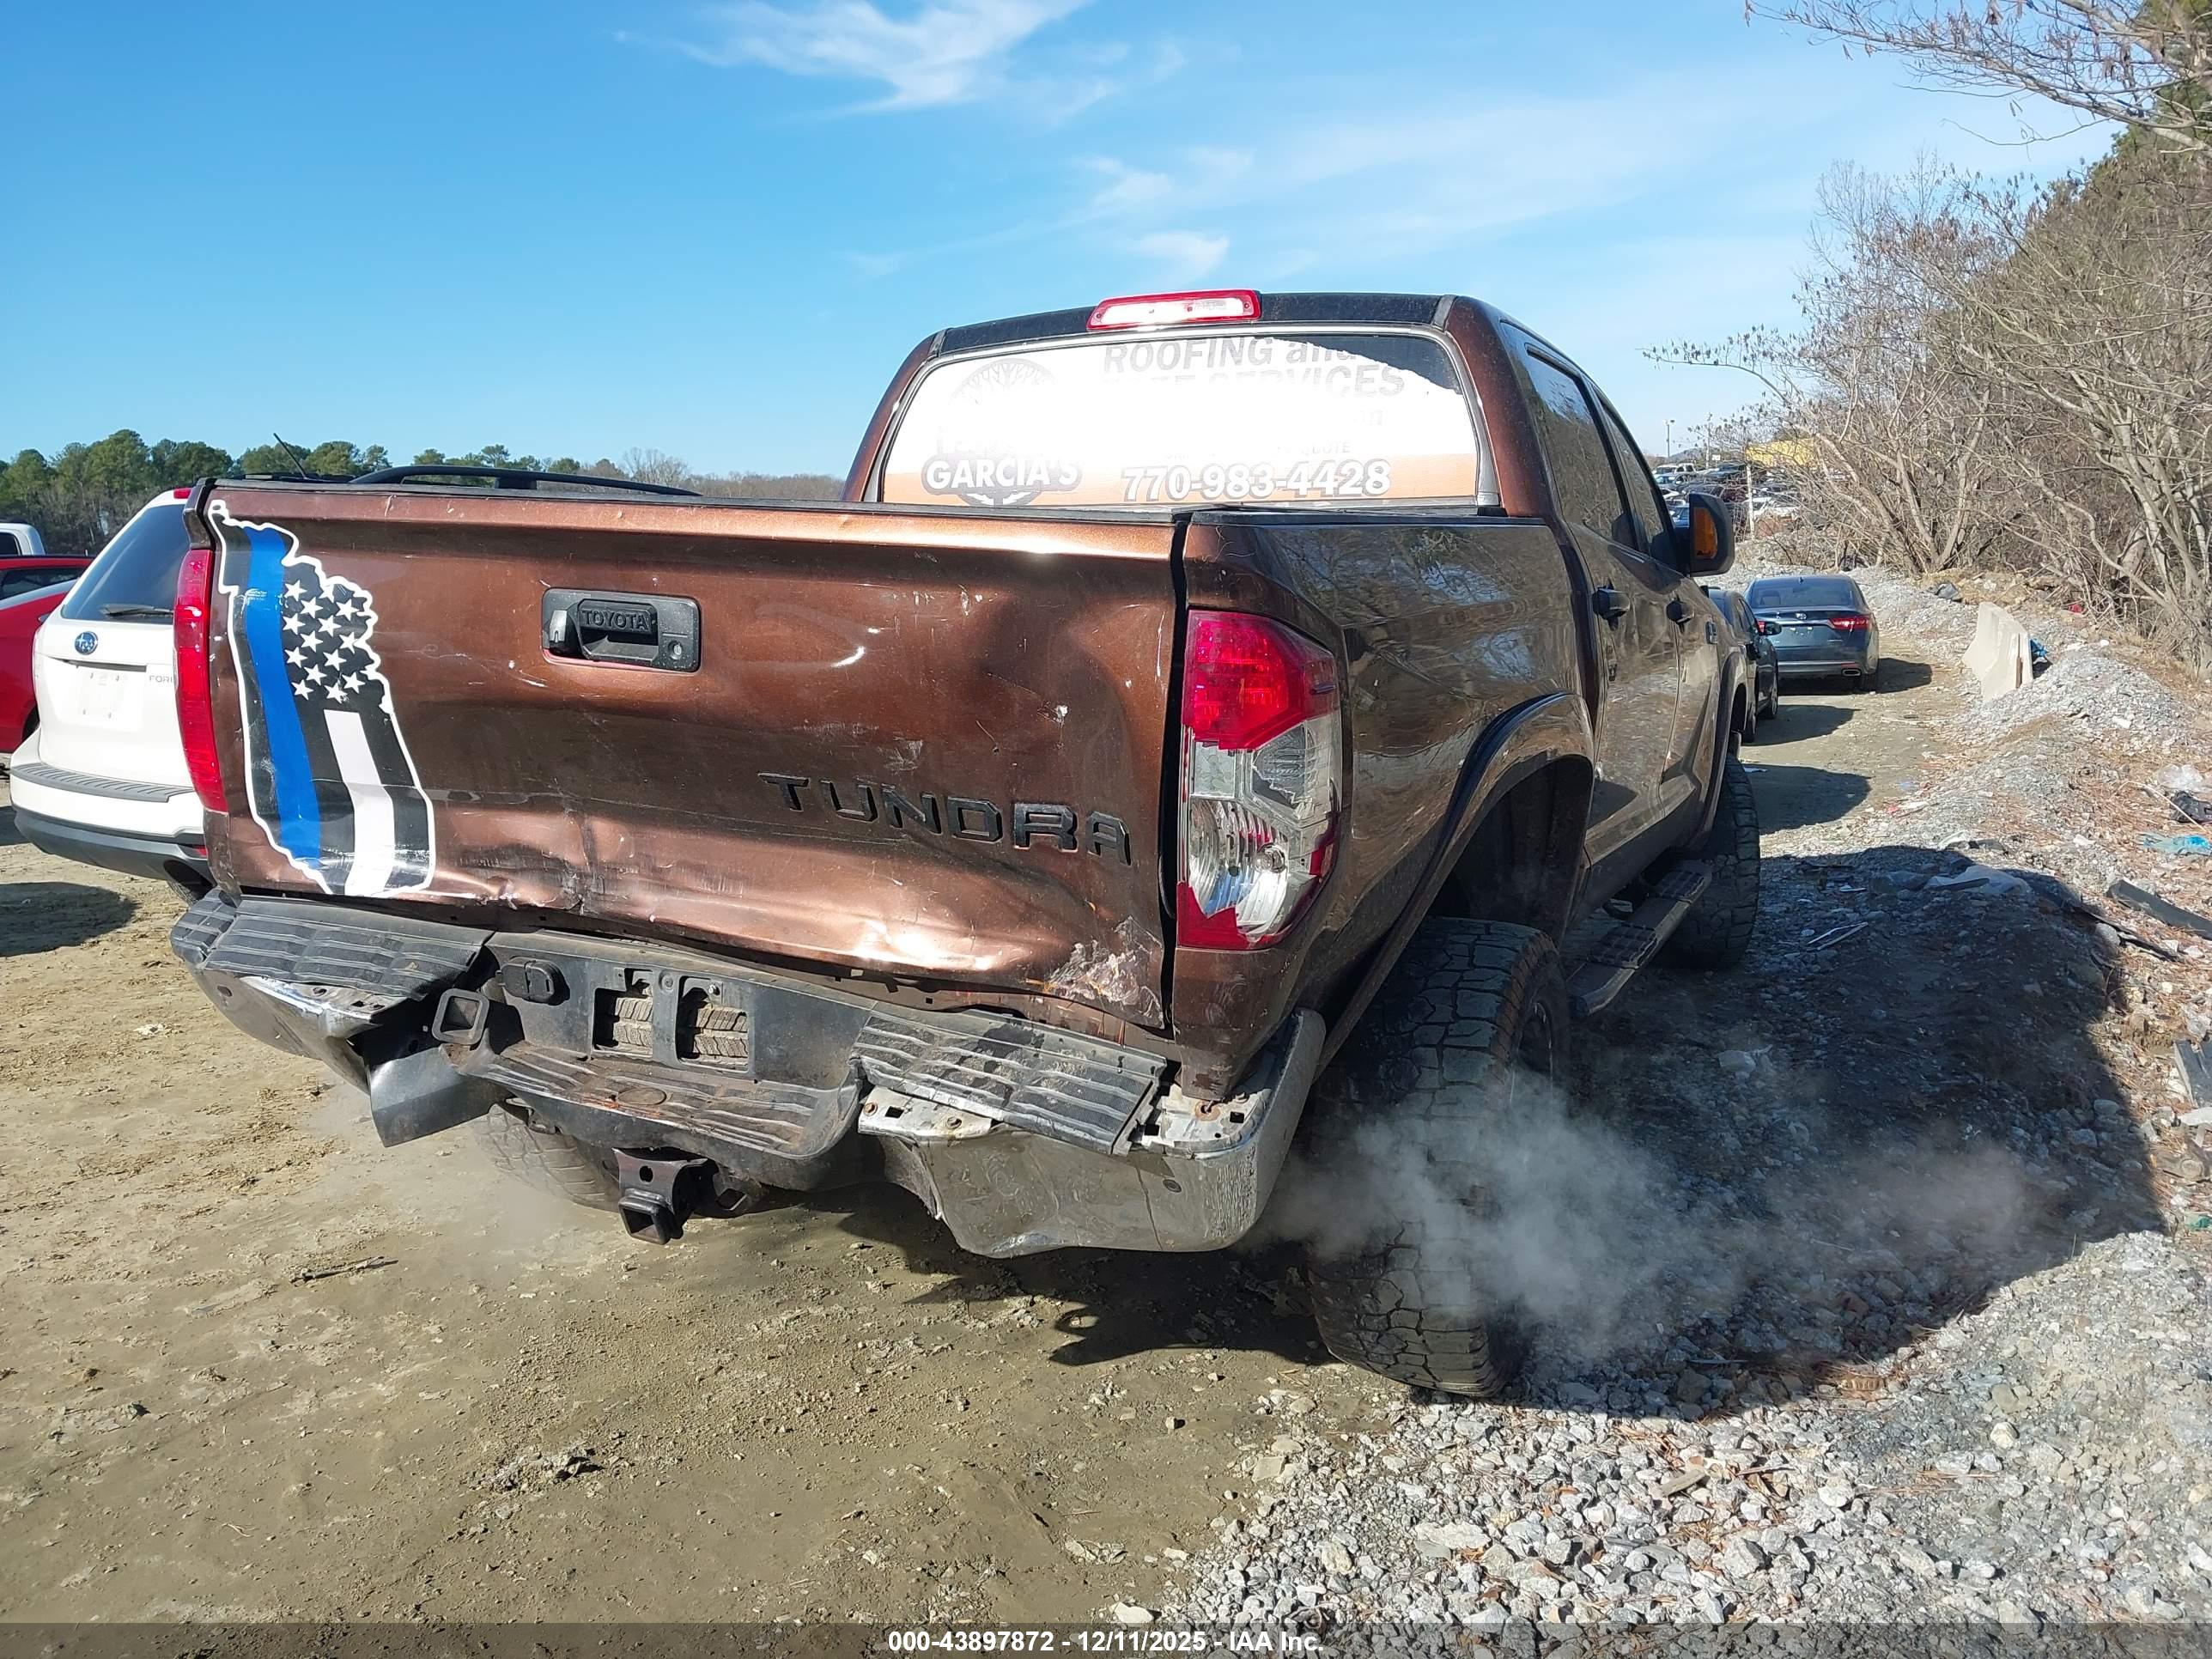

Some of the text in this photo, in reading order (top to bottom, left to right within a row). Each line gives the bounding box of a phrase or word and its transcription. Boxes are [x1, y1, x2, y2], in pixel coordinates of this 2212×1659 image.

[1103, 337, 1273, 373] ROOFING
[926, 455, 1079, 489] GARCIA'S
[1122, 458, 1391, 501] 770-983-4428
[582, 609, 649, 631] TOYOTA
[758, 772, 1132, 866] TUNDRA
